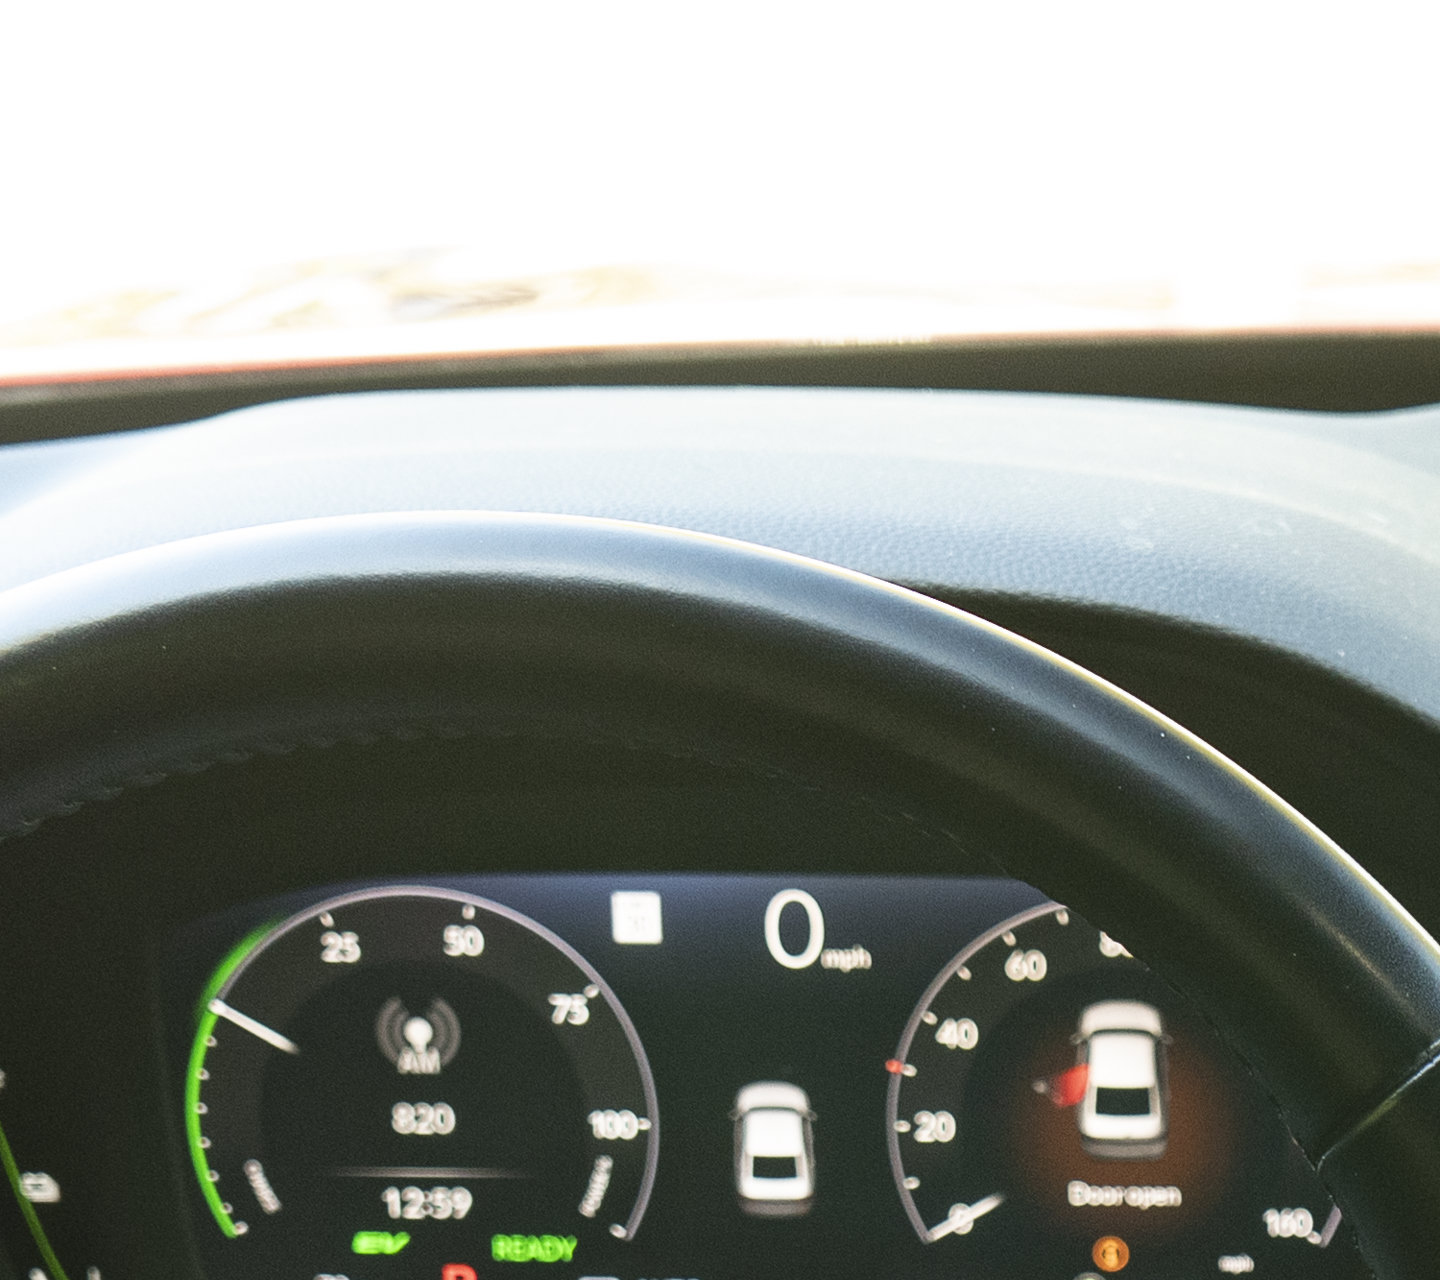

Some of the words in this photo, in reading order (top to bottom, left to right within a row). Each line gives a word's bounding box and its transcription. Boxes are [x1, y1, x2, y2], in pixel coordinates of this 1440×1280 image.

[764, 888, 823, 970] 0
[1004, 950, 1048, 982] 60
[934, 1017, 980, 1051] 40
[391, 1102, 456, 1136] 820
[914, 1110, 957, 1143] 20
[384, 1186, 473, 1220] 12:59
[491, 1234, 578, 1263] READY
